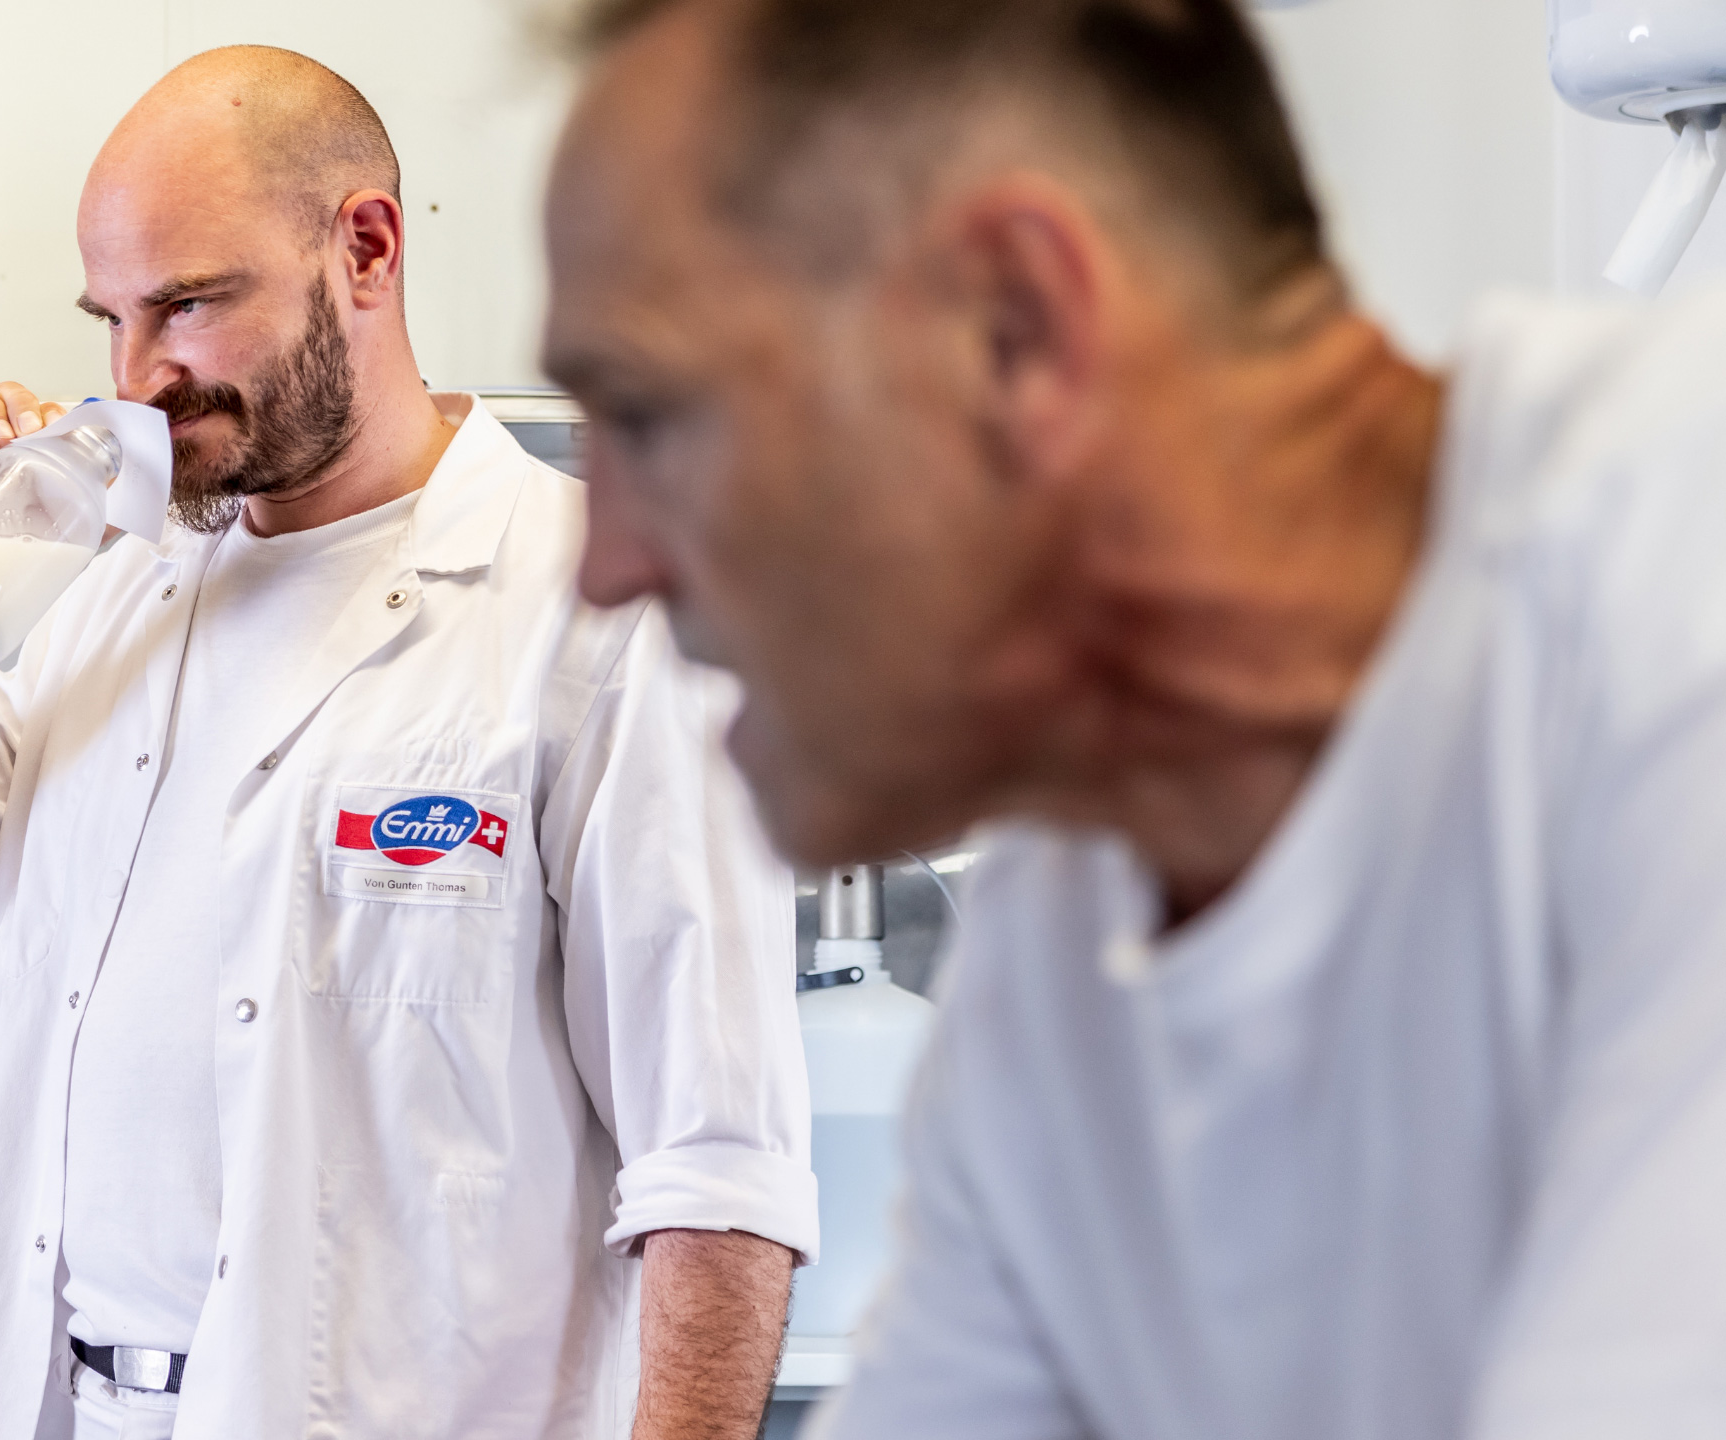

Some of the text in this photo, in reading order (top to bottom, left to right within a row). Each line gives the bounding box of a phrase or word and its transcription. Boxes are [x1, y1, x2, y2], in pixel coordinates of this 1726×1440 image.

[381, 810, 471, 842] Emmi
[364, 878, 466, 892] Von Gunten Thomas
